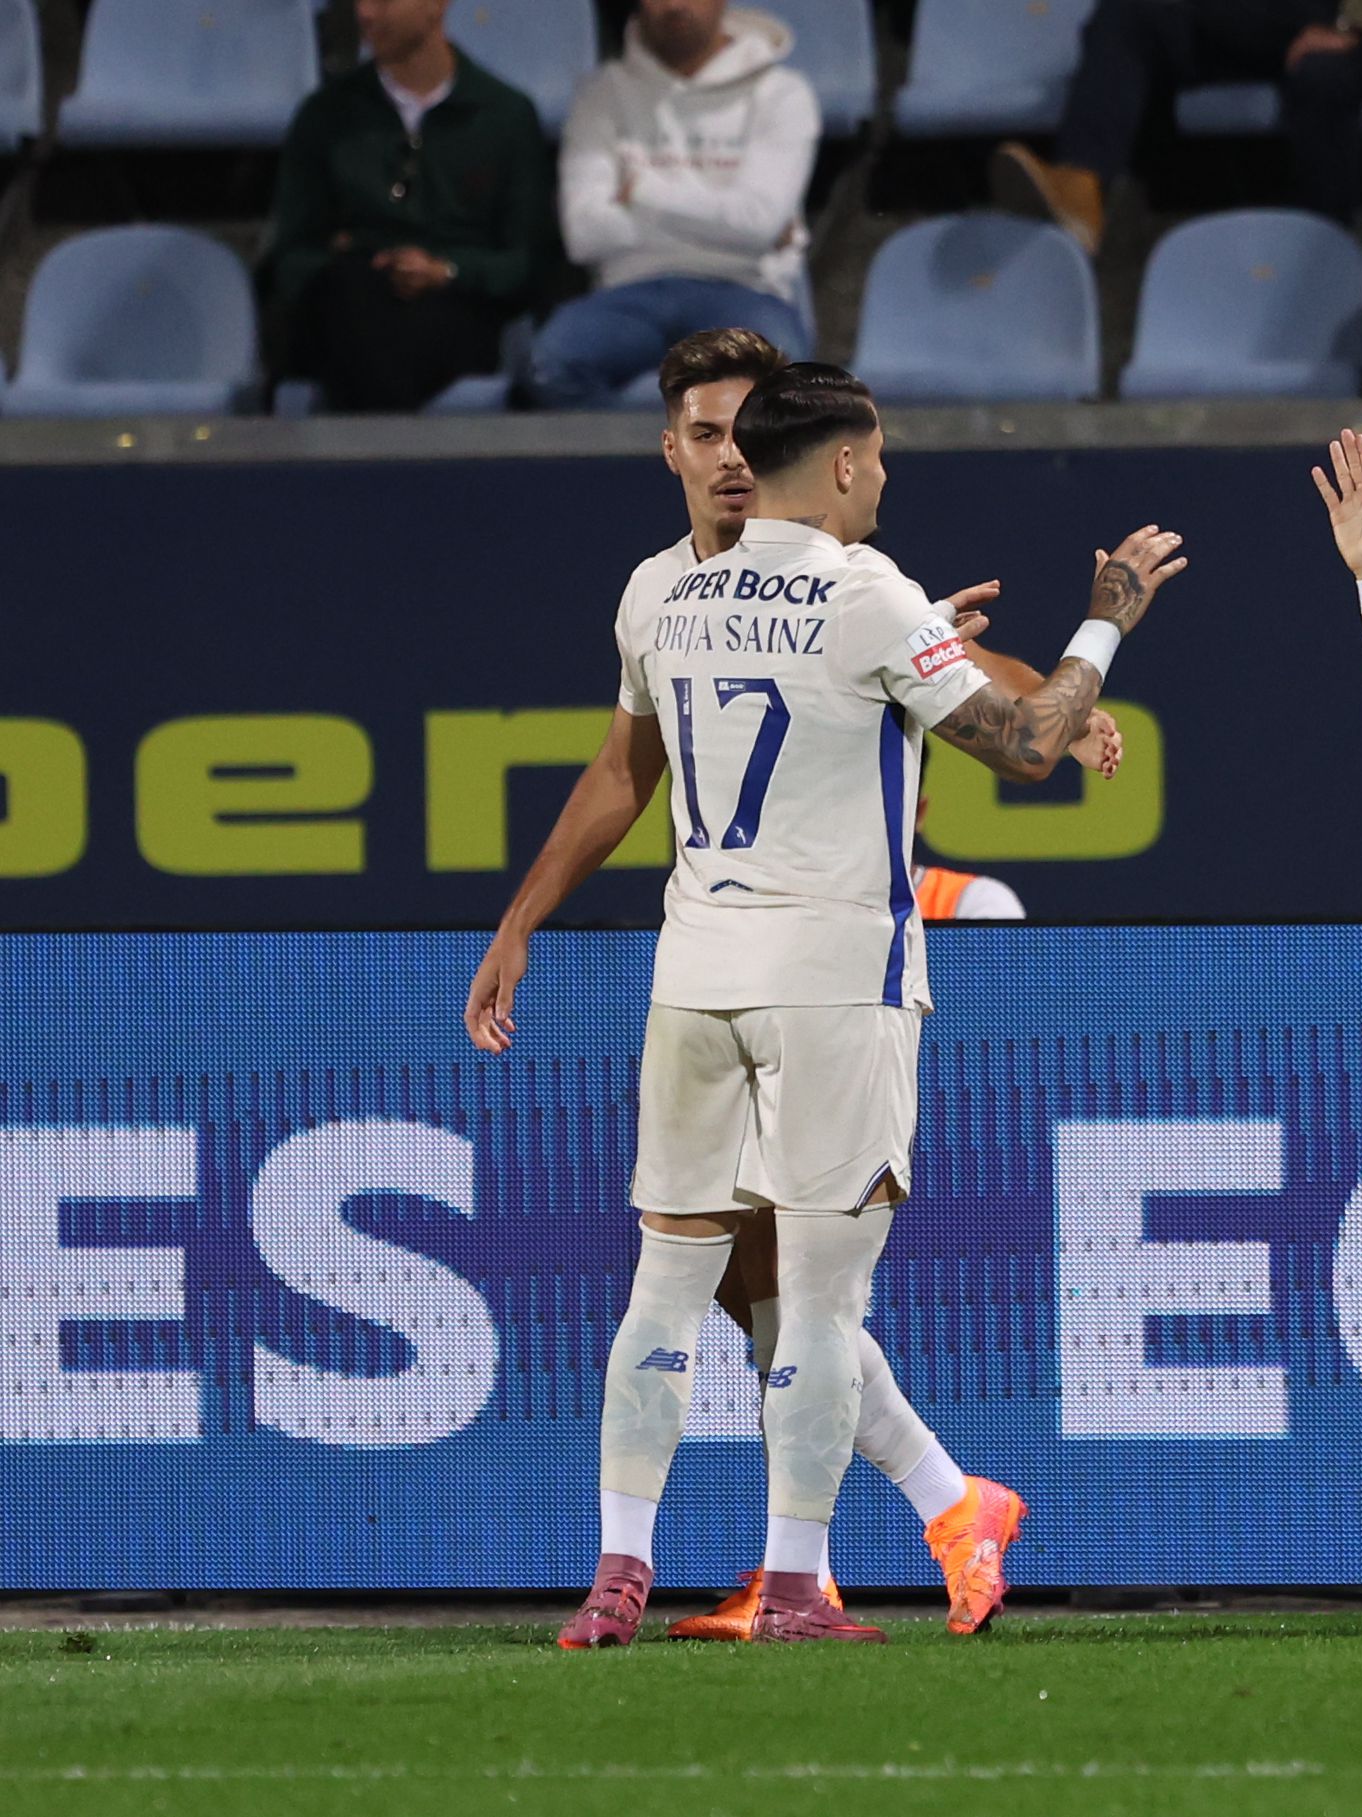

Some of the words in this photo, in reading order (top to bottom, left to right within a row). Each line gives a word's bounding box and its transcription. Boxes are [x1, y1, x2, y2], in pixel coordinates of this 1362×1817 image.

[733, 568, 837, 606] BOCK
[655, 614, 713, 659] ORJA
[725, 614, 826, 655] SAINZ
[671, 677, 792, 850] 17
